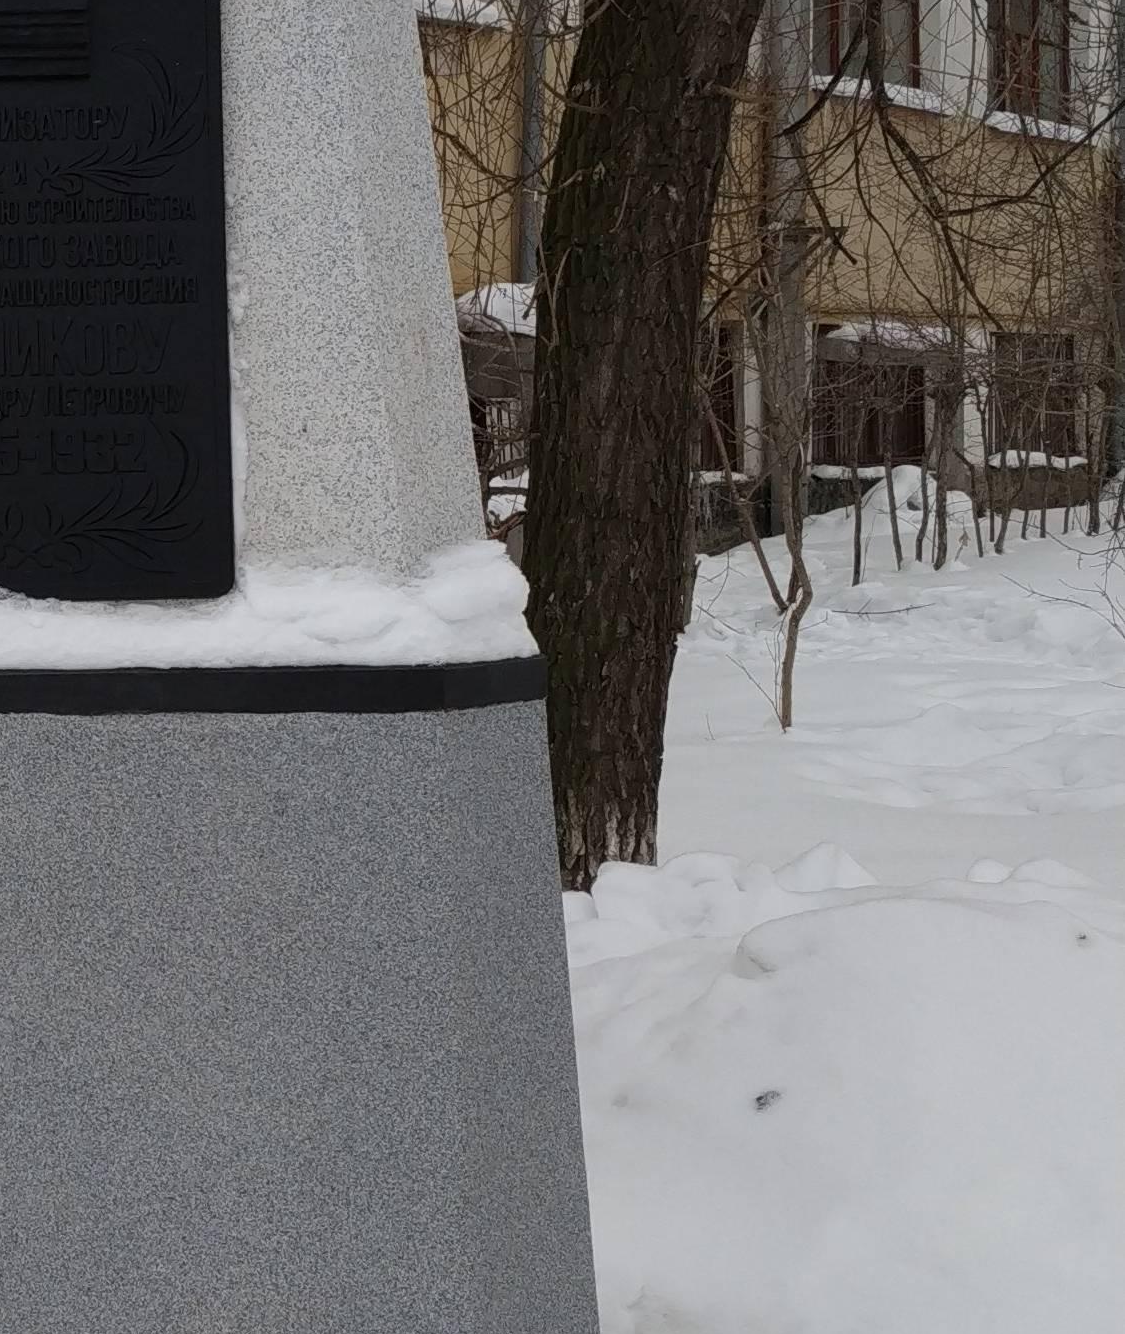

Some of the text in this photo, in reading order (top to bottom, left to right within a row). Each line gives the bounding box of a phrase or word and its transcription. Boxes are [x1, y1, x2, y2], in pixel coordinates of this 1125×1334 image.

[26, 195, 197, 224] СТРОИТЕЛЬСТВА
[64, 229, 184, 269] ЗАВОДА
[43, 382, 190, 418] ПЕТРОВИЧУ
